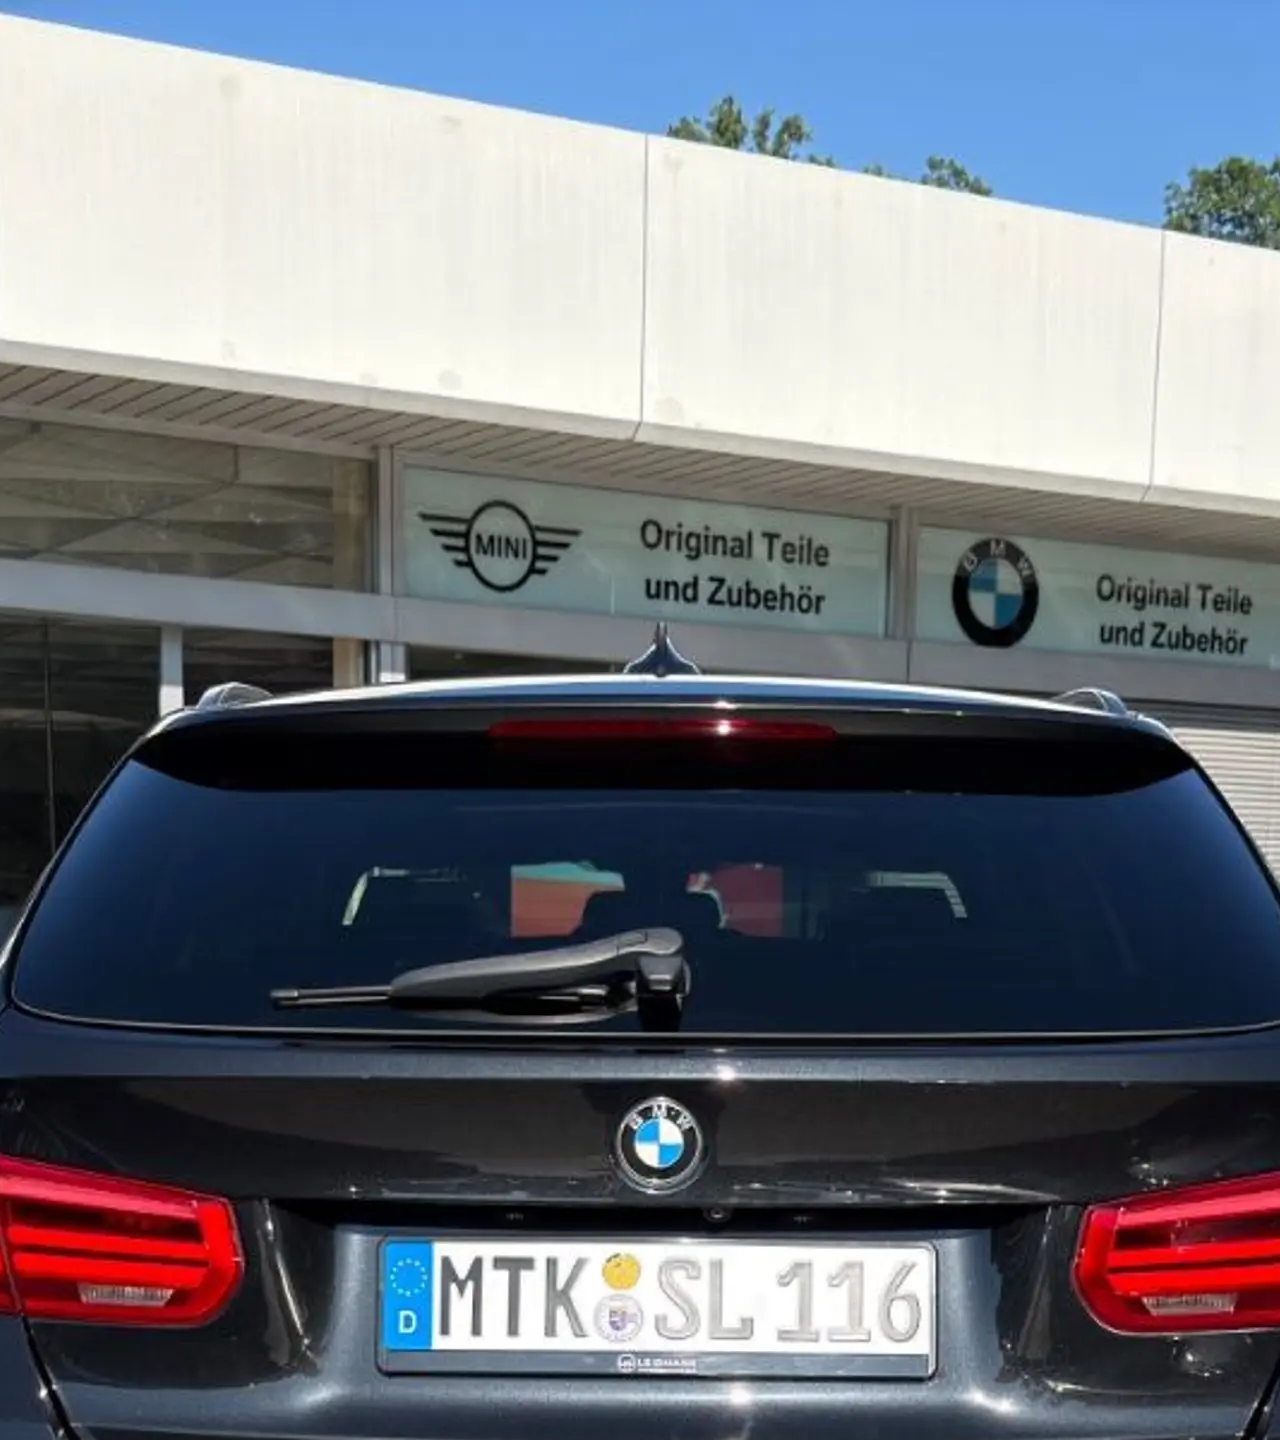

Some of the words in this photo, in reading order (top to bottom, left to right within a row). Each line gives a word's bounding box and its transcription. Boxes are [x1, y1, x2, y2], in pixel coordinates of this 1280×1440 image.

[475, 533, 527, 560] MINI
[640, 518, 754, 561] Original
[761, 531, 830, 567] Teile
[963, 539, 1034, 577] BMW
[644, 574, 700, 604] und
[706, 575, 826, 615] Zubehör
[1096, 573, 1190, 611] Original
[1196, 583, 1253, 615] Teile
[1099, 621, 1145, 647] und
[1150, 621, 1248, 655] Zubehör
[626, 1103, 695, 1131] BMW
[398, 1310, 417, 1333] D
[439, 1255, 589, 1338] MTK
[654, 1258, 754, 1341] SL
[776, 1260, 921, 1343] 116
